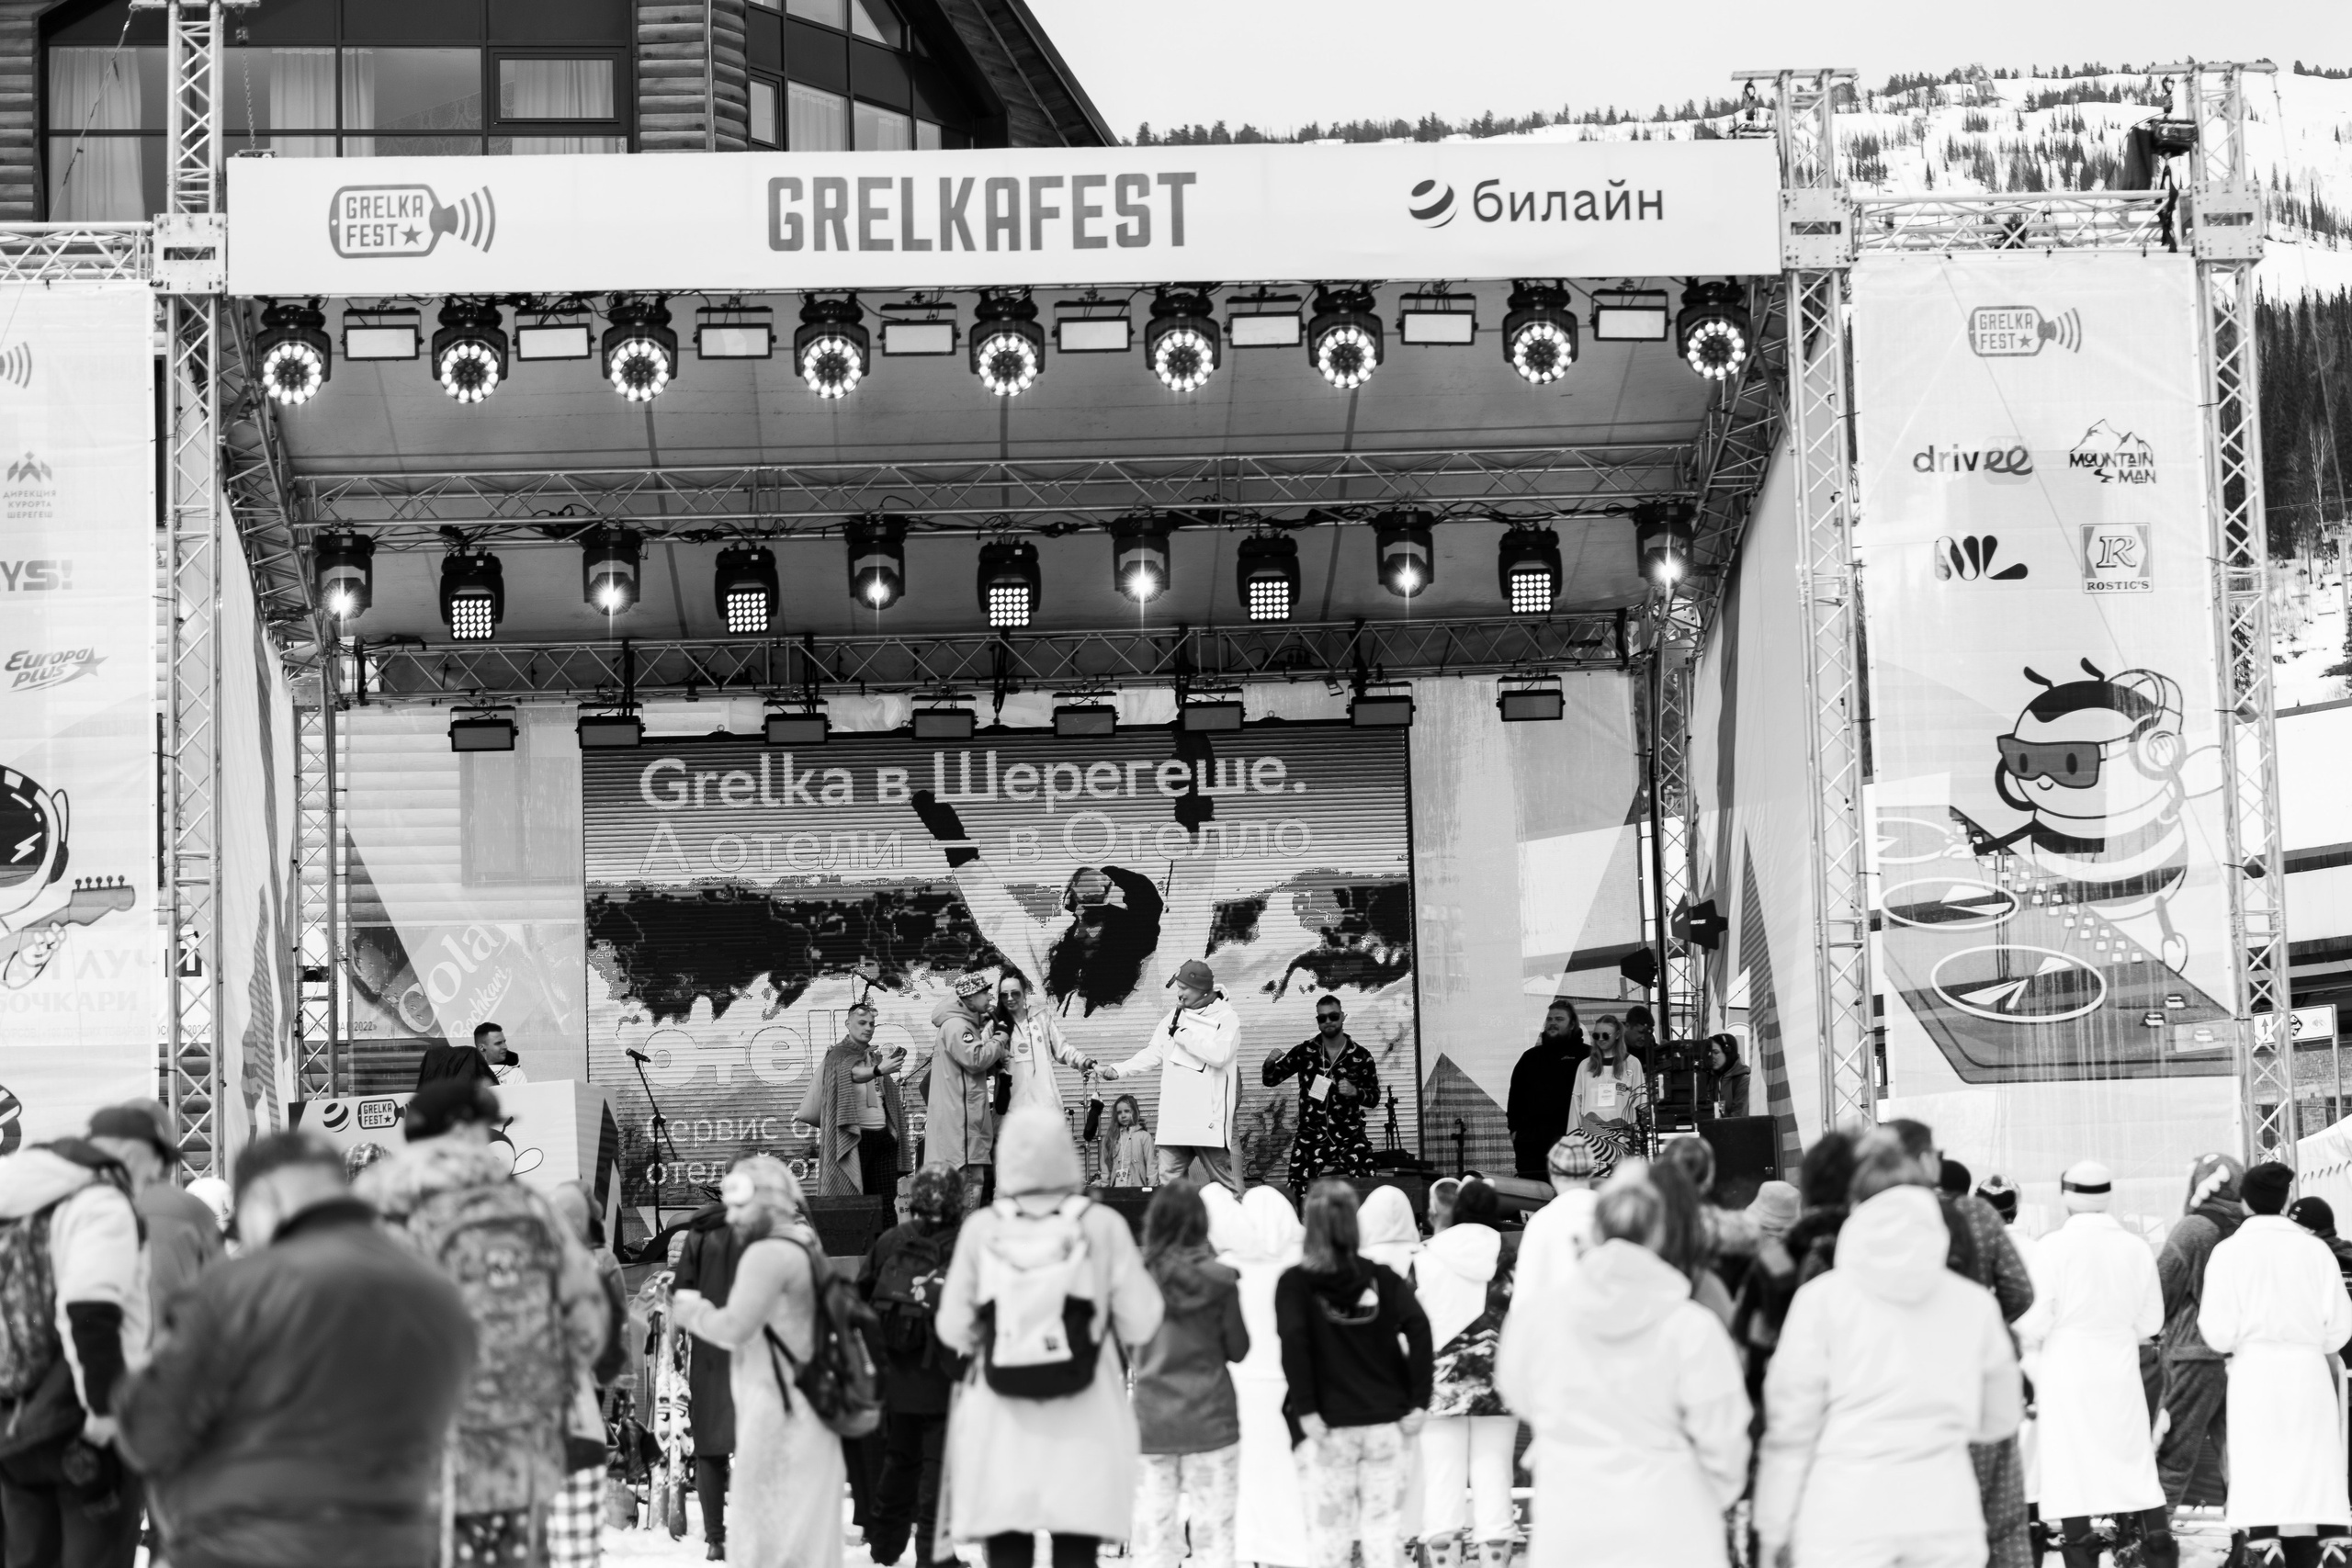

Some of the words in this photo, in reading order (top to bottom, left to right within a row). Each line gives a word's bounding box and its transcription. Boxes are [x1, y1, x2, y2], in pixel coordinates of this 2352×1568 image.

[345, 193, 424, 220] GRELKA
[768, 172, 1197, 252] GRELKAFEST
[1473, 178, 1664, 223] билайн
[346, 223, 399, 248] FEST
[1979, 312, 2033, 331] GRELKA
[1980, 333, 2017, 350] FEST
[1912, 443, 2033, 476] drivee
[2119, 468, 2157, 485] MAN
[3, 490, 57, 500] ДИРЕКЦИЯ
[7, 501, 52, 510] КУРОРТА
[6, 511, 53, 519] ШЕРЕГЕШ
[2086, 581, 2150, 592] ROSTIC'S
[5, 648, 90, 672] Europa
[639, 751, 854, 811] Grelka
[876, 766, 912, 805] в
[933, 750, 1307, 814] Шерегеше.
[639, 821, 693, 874] А
[709, 829, 904, 873] отели
[1010, 826, 1043, 864] в
[1062, 809, 1313, 863] Отелло
[399, 924, 501, 1033] Cola
[450, 965, 507, 1038] Bochkari
[363, 1102, 393, 1115] GRELKA
[364, 1114, 383, 1126] FEST
[646, 1112, 779, 1148] Сервис
